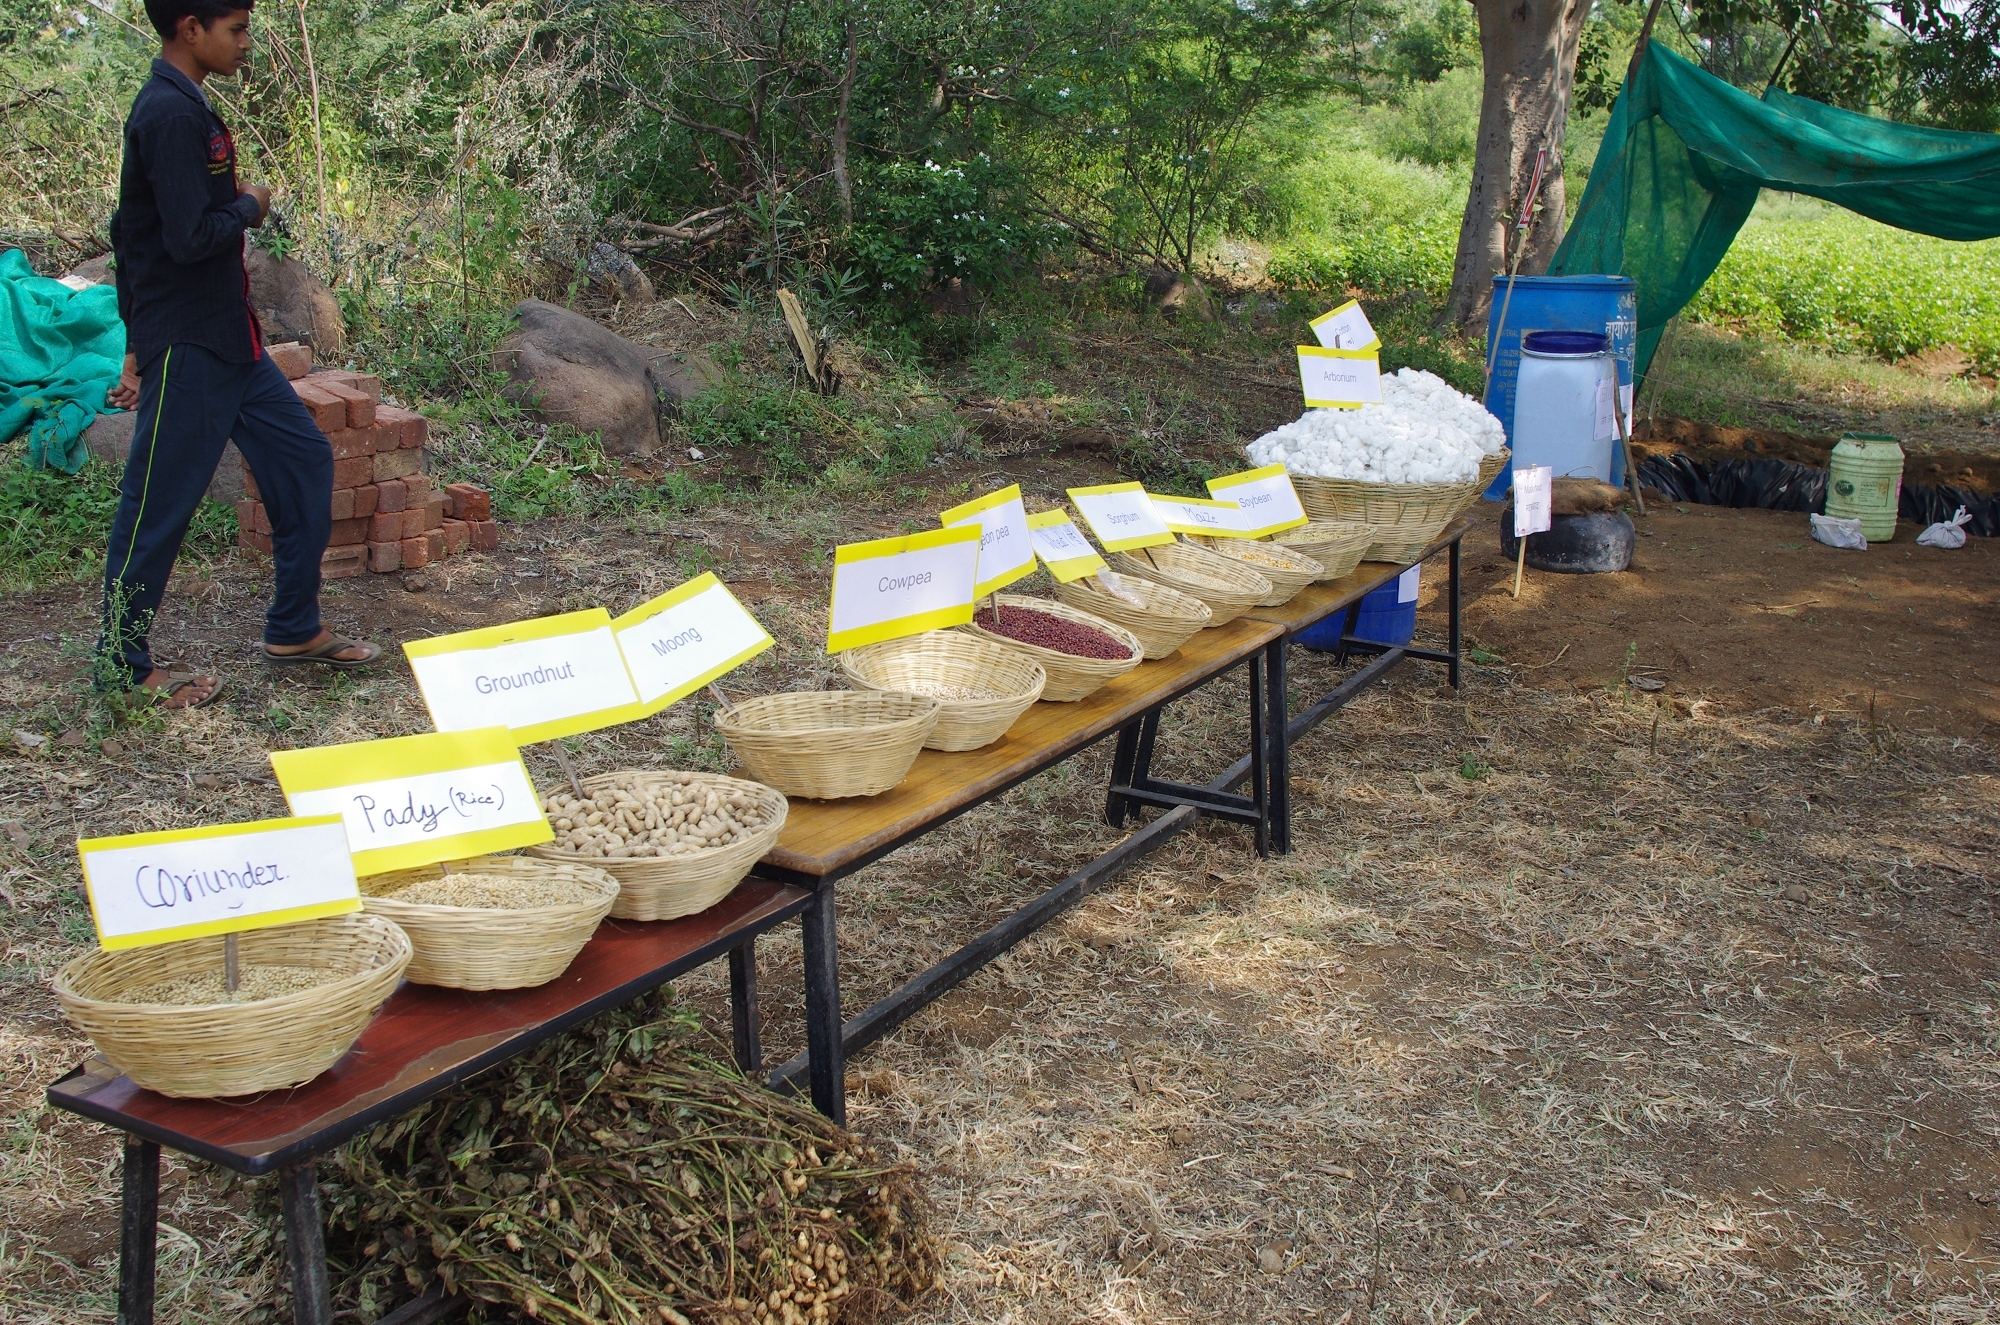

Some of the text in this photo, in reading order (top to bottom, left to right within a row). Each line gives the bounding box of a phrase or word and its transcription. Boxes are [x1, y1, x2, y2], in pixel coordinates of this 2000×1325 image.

[1324, 371, 1357, 383] Arborium
[1239, 493, 1272, 508] Soybean
[1107, 512, 1140, 525] Sorghum
[1183, 507, 1218, 523] Maize
[995, 525, 1009, 543] pea
[878, 571, 932, 593] Cowpea
[651, 627, 703, 657] Moong
[475, 661, 575, 694] Groundnut
[354, 784, 505, 832] Pady (Rice)
